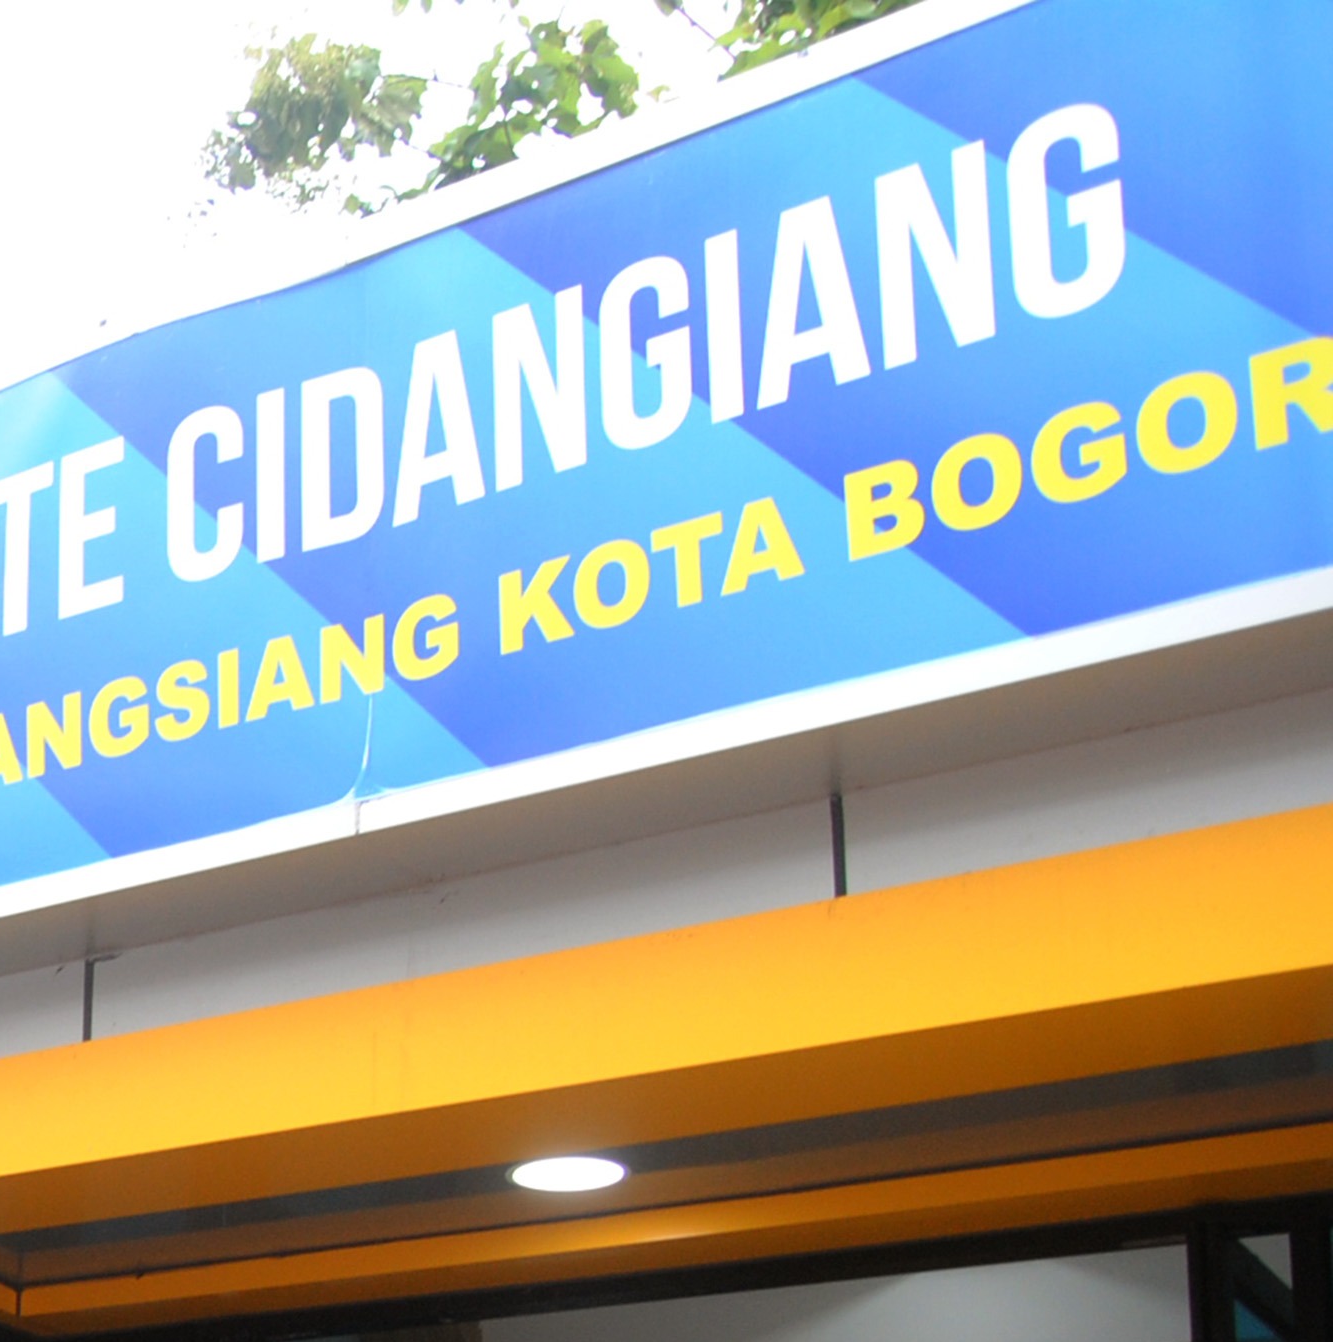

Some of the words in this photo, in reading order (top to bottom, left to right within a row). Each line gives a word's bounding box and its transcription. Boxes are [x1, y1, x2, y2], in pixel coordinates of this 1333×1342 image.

[167, 102, 1126, 582] CIDANGIANG
[498, 497, 805, 656] KOTA
[844, 336, 1333, 562] BOGOR
